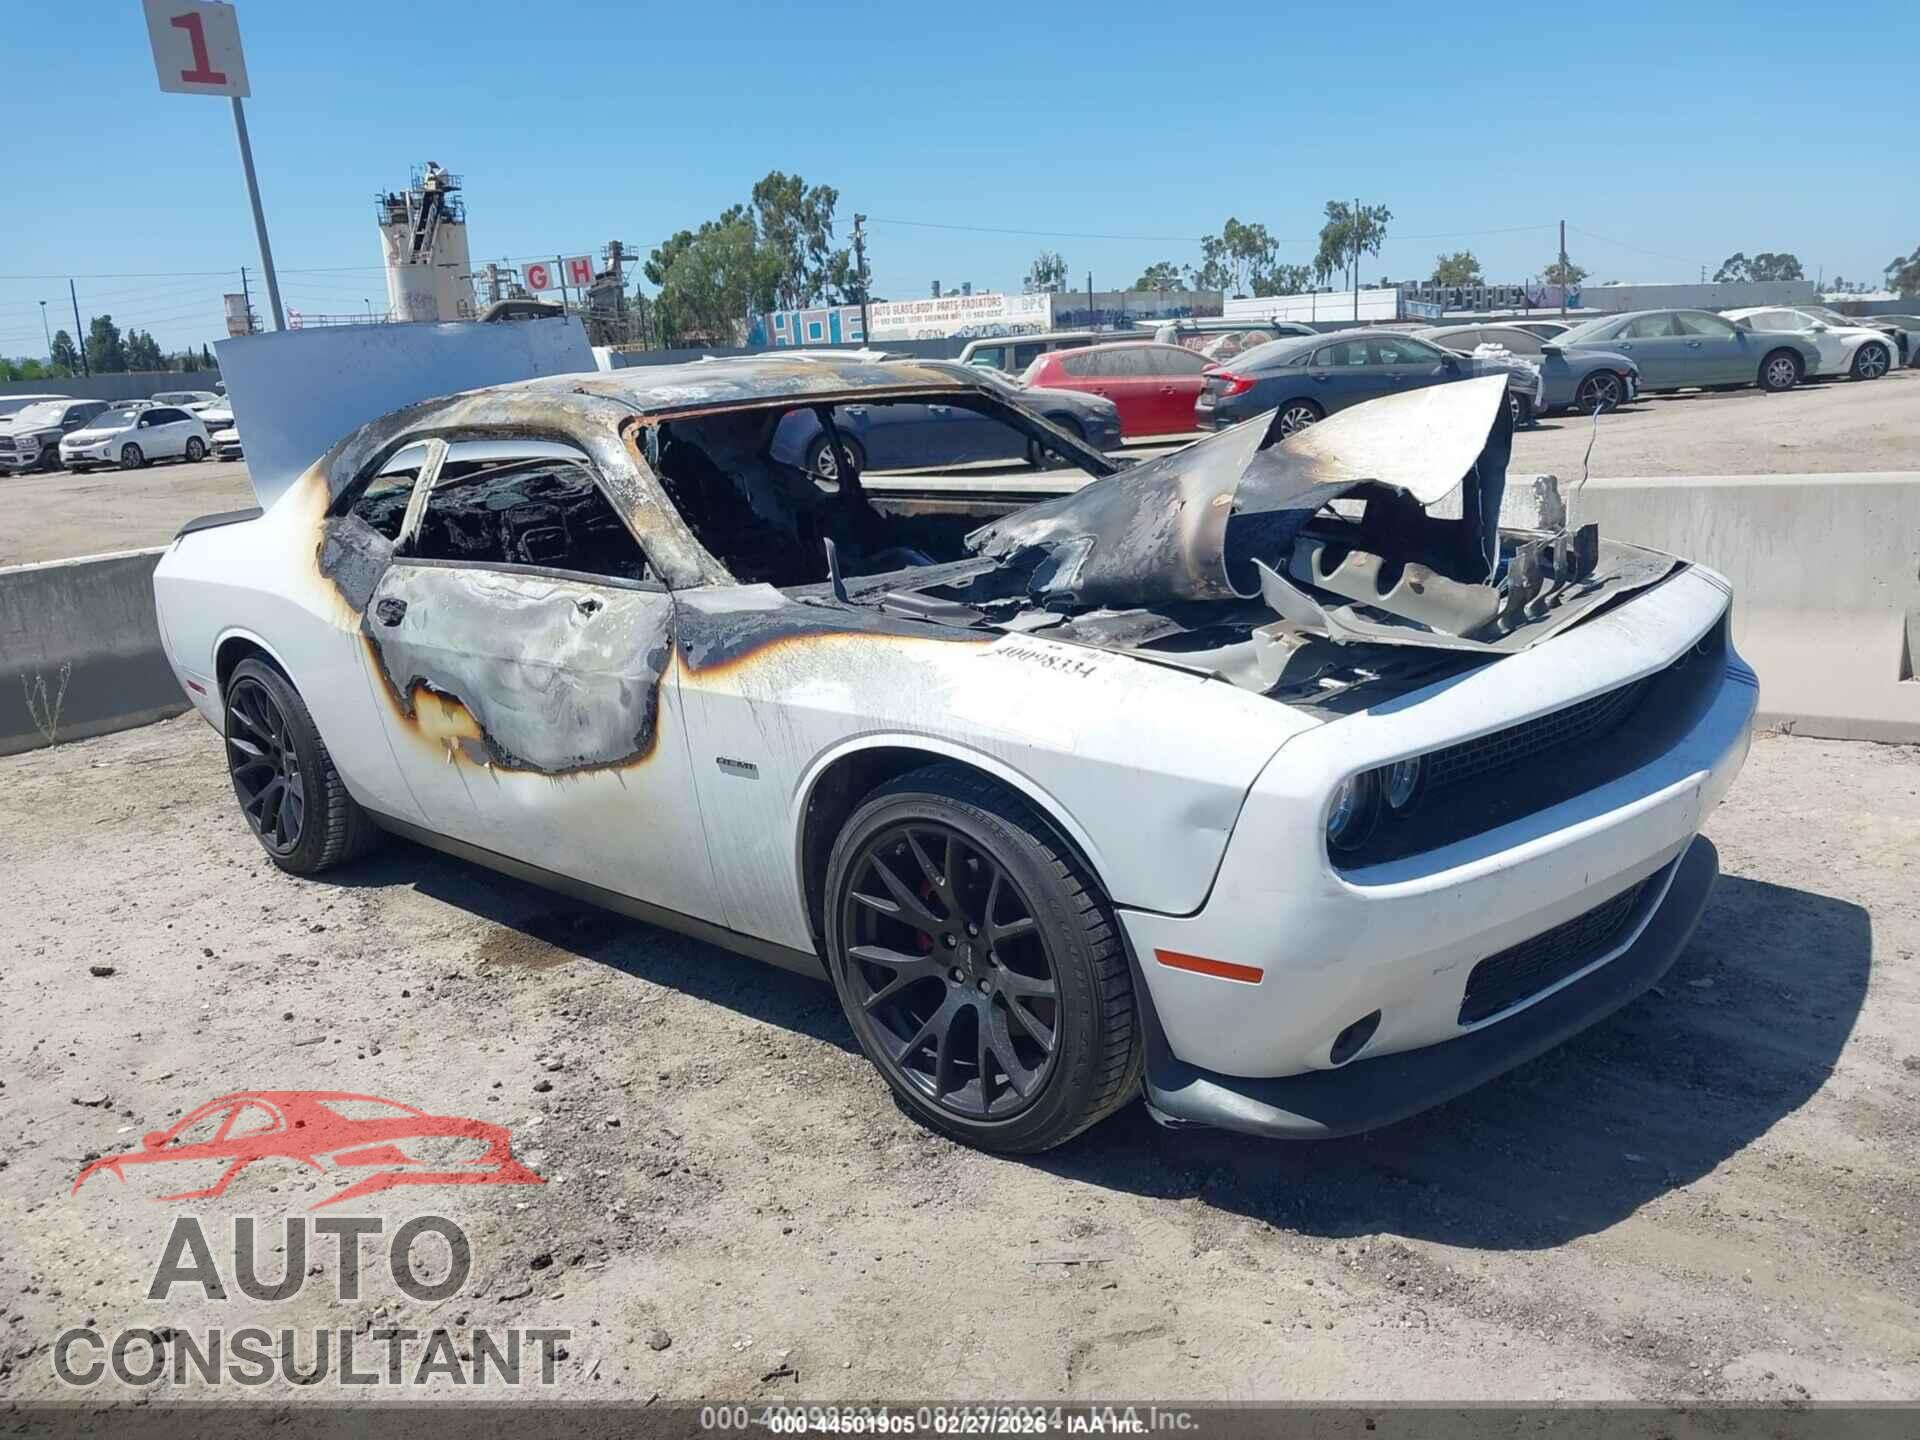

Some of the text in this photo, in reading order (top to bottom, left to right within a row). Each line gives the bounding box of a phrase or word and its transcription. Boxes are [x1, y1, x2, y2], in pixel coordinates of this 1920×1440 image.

[170, 12, 227, 85] 1
[528, 265, 547, 289] G
[570, 259, 590, 283] H
